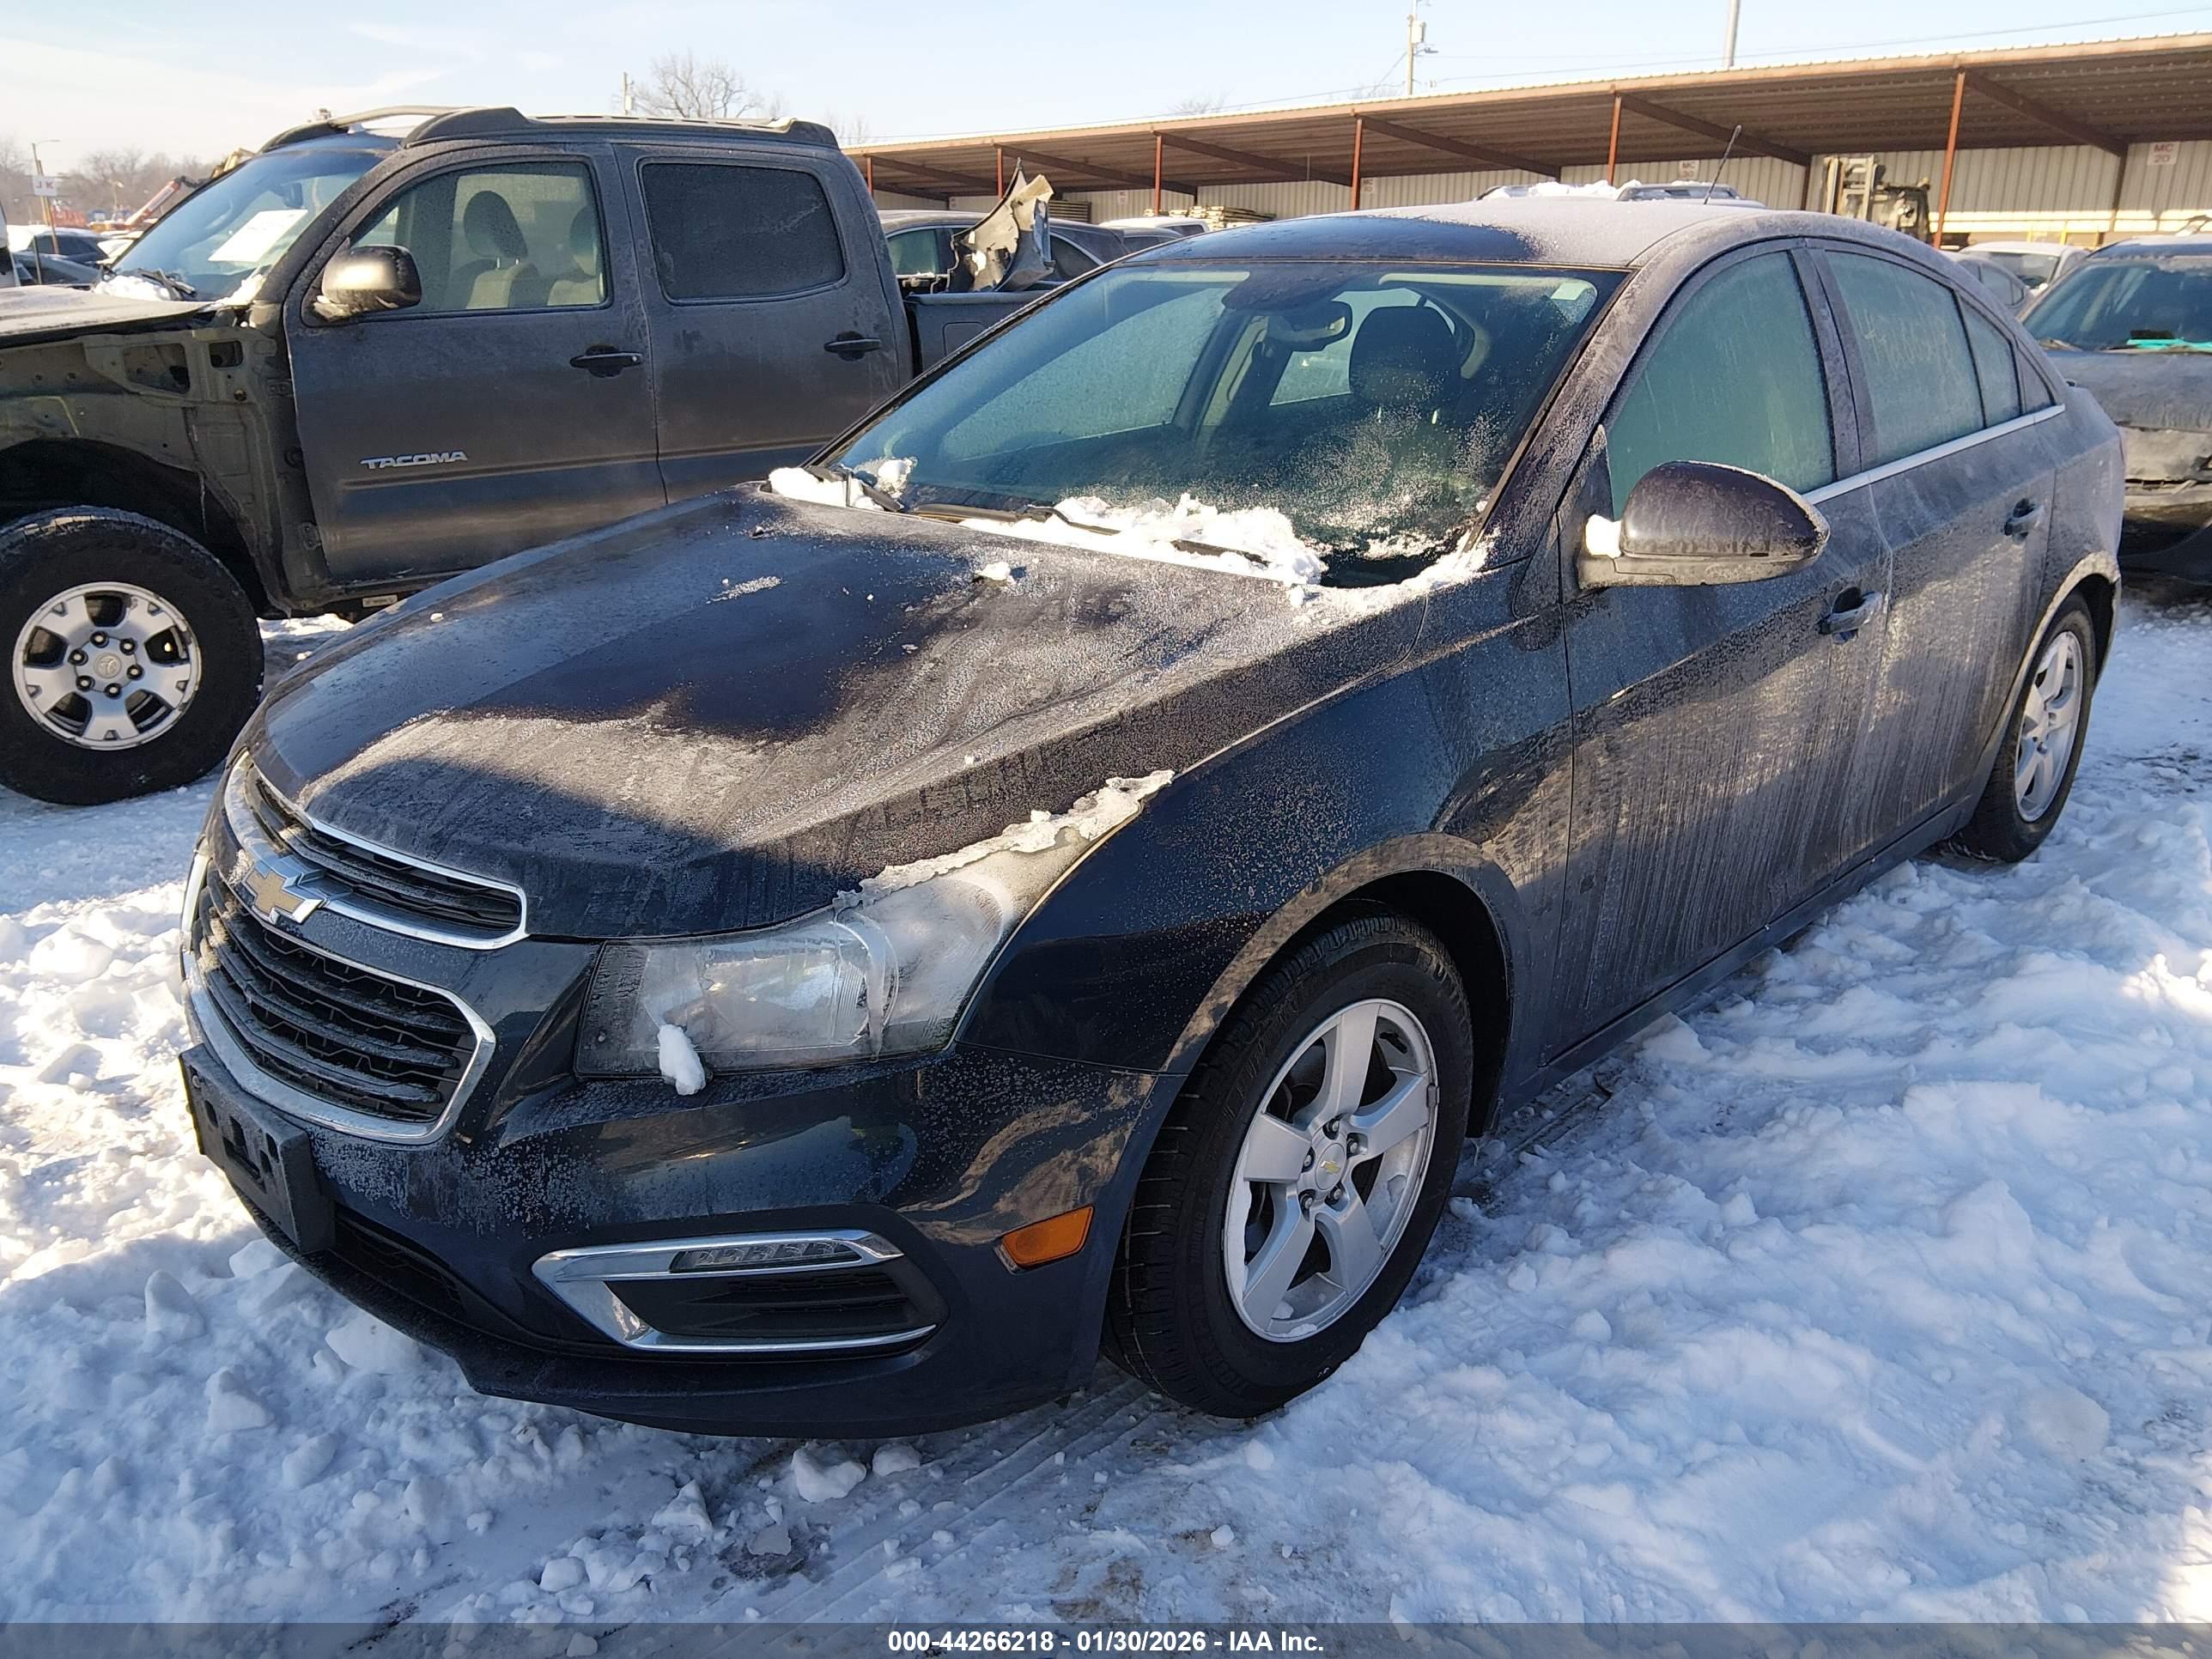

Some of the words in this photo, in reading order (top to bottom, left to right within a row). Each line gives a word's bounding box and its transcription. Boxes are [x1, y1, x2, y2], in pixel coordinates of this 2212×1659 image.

[2154, 143, 2174, 153] MC
[2154, 155, 2171, 163] 20
[360, 450, 468, 470] TACOMA
